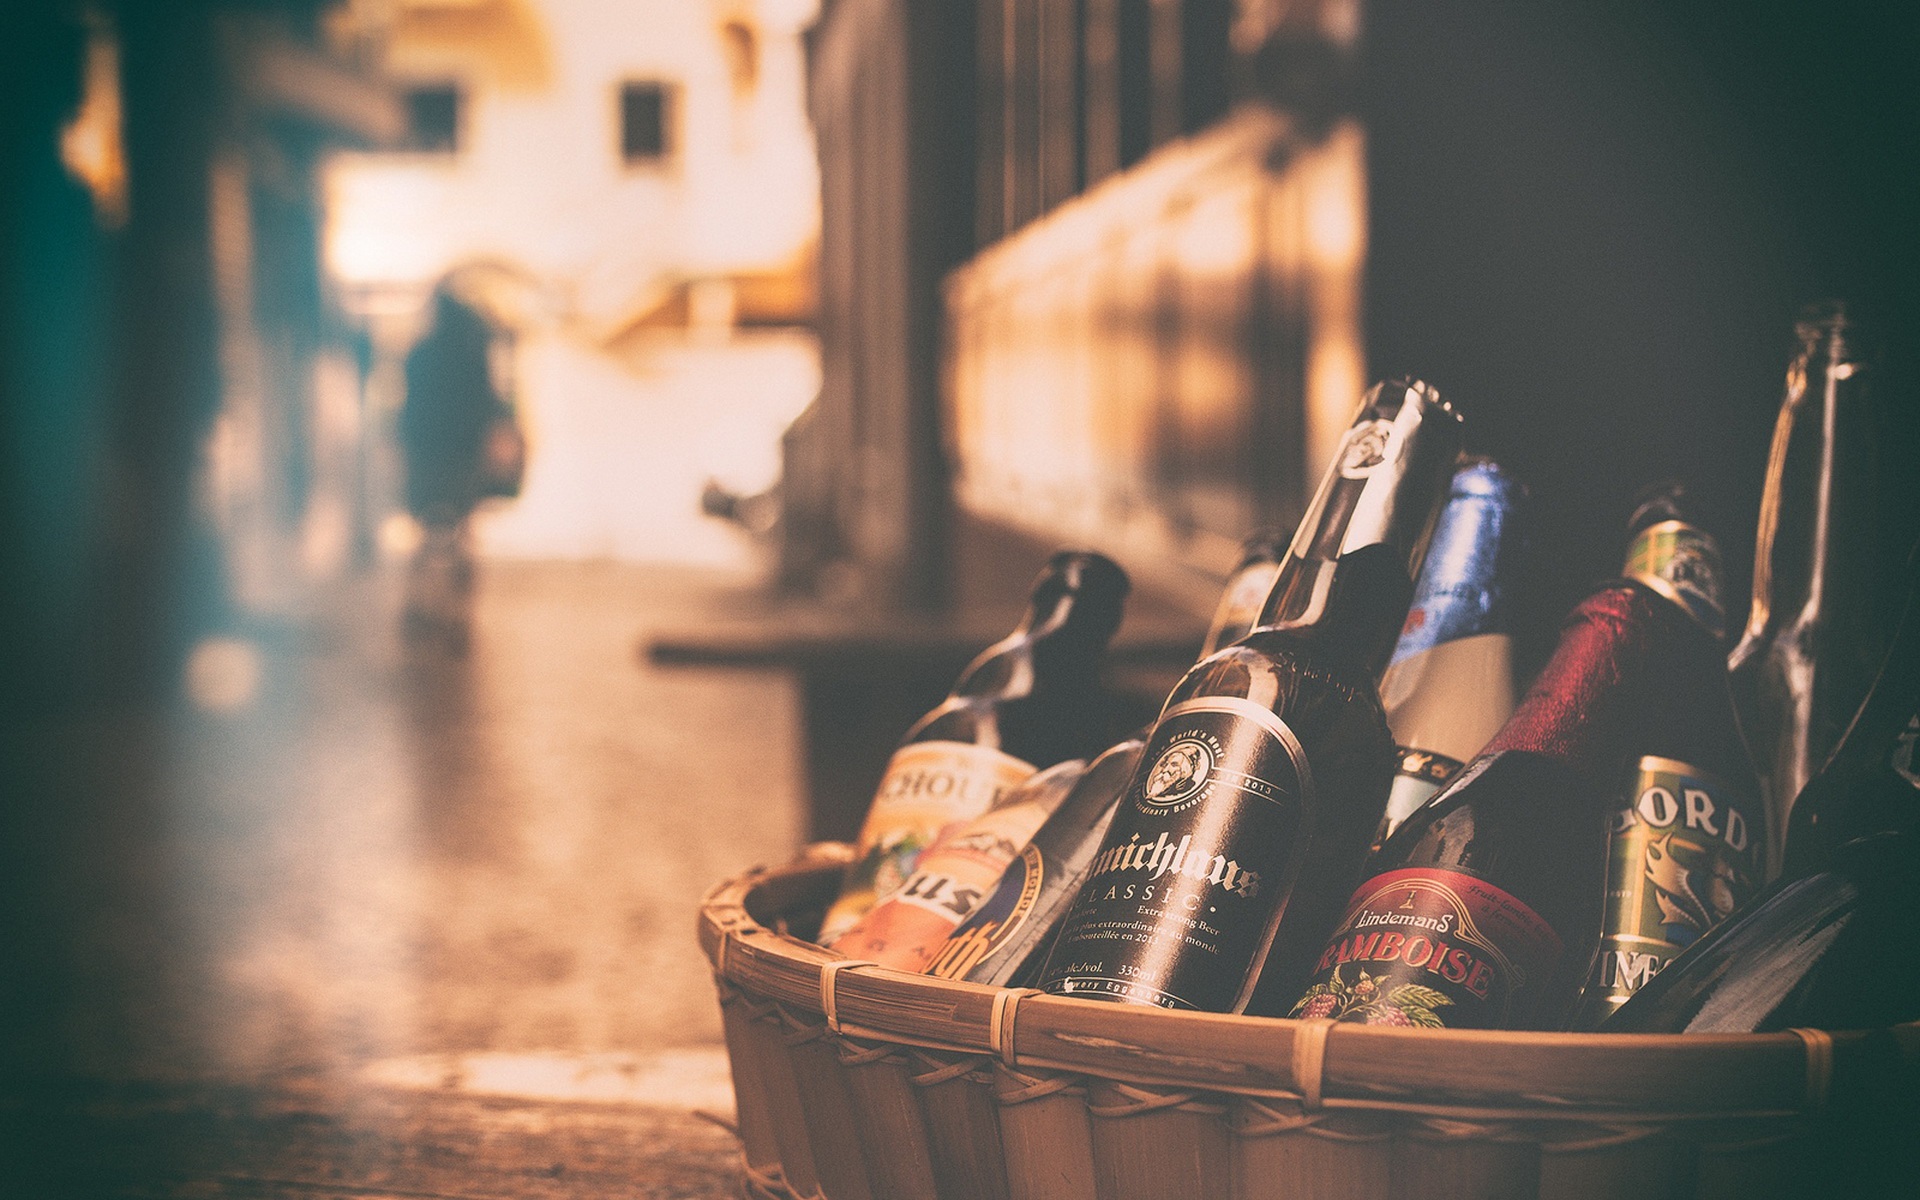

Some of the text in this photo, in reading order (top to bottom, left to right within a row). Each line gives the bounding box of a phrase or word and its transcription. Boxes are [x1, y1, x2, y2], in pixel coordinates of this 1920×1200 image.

[1207, 735, 1226, 759] Most
[1173, 783, 1217, 814] Beverage
[1243, 778, 1273, 796] 2013
[1087, 831, 1261, 898] michlaus
[1137, 904, 1164, 917] Extra
[1198, 920, 1220, 936] Beer
[1121, 933, 1134, 941] en
[1185, 936, 1220, 955] monde
